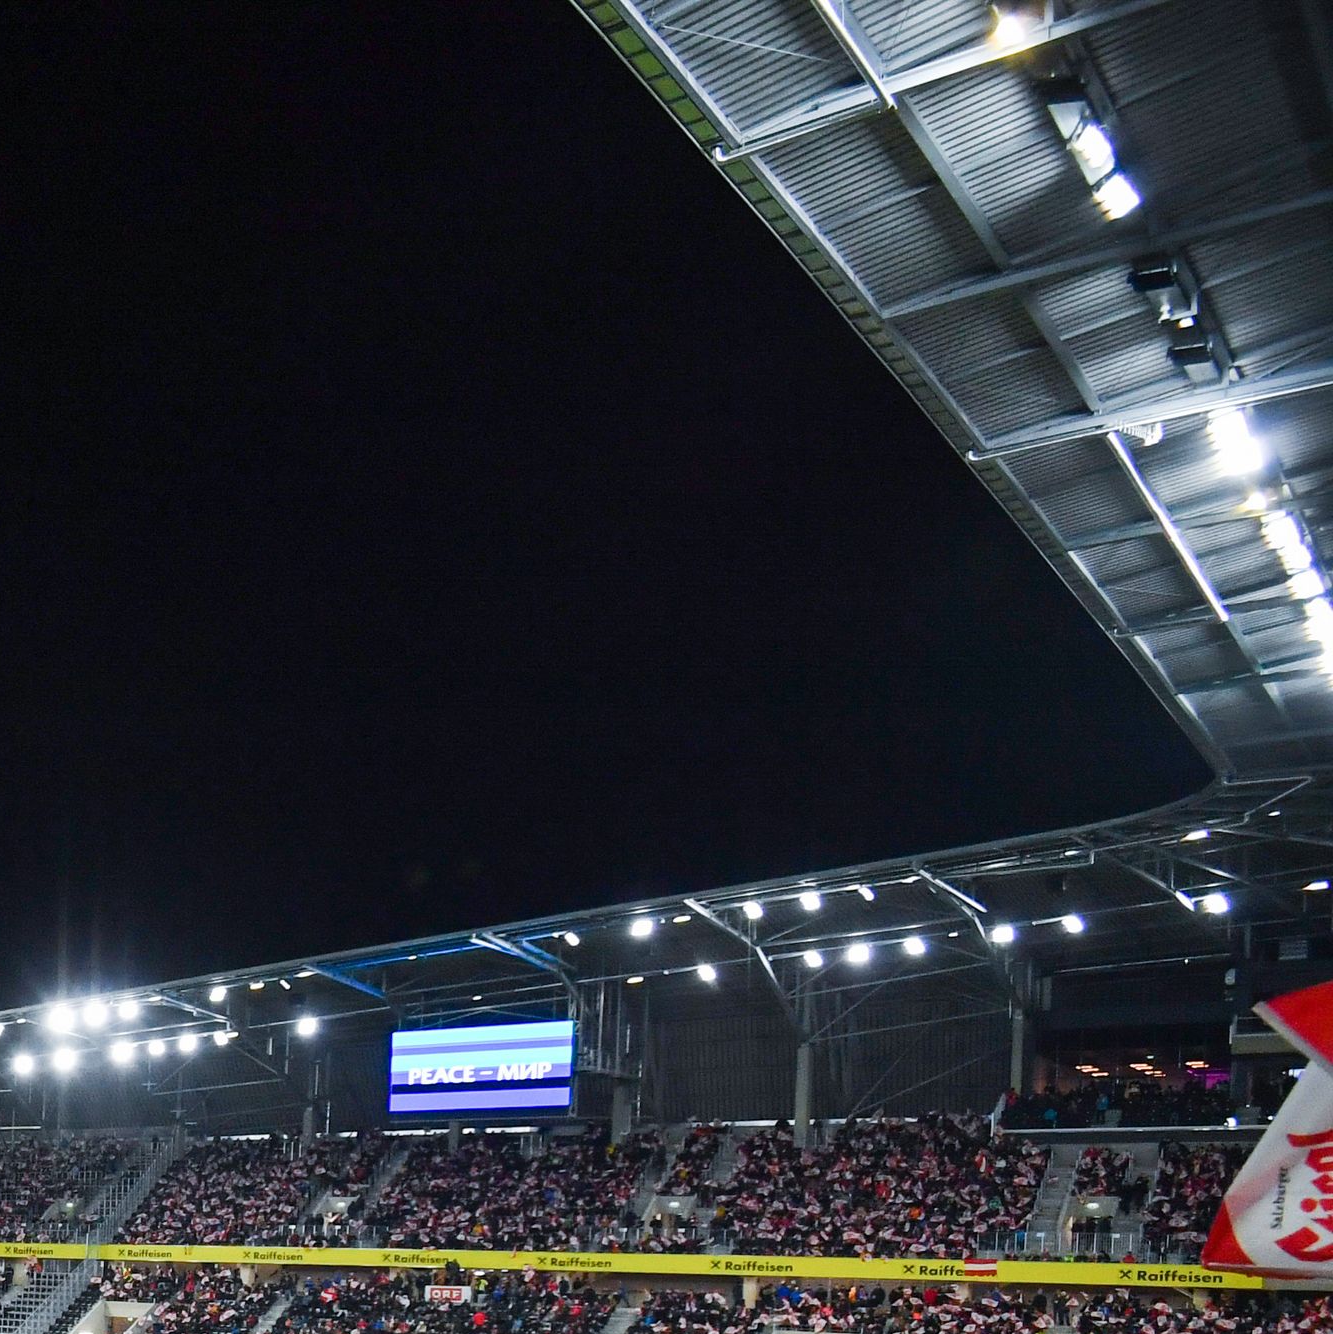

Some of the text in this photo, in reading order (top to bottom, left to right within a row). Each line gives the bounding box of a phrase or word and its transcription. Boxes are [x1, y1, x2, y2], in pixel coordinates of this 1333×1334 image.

[408, 1066, 476, 1085] PEACE
[496, 1062, 552, 1081] МИР
[13, 1246, 54, 1256] Raiffeisen
[127, 1249, 172, 1259] Raiffeisen
[253, 1251, 303, 1262] Raiffeisen
[393, 1254, 449, 1265] Raiffeisen
[550, 1257, 612, 1268] Raiffeisen
[725, 1261, 793, 1272] Raiffeisen
[920, 1265, 965, 1277] Raiffe
[1137, 1270, 1223, 1284] Raiffeisen
[432, 1289, 461, 1300] ORF
